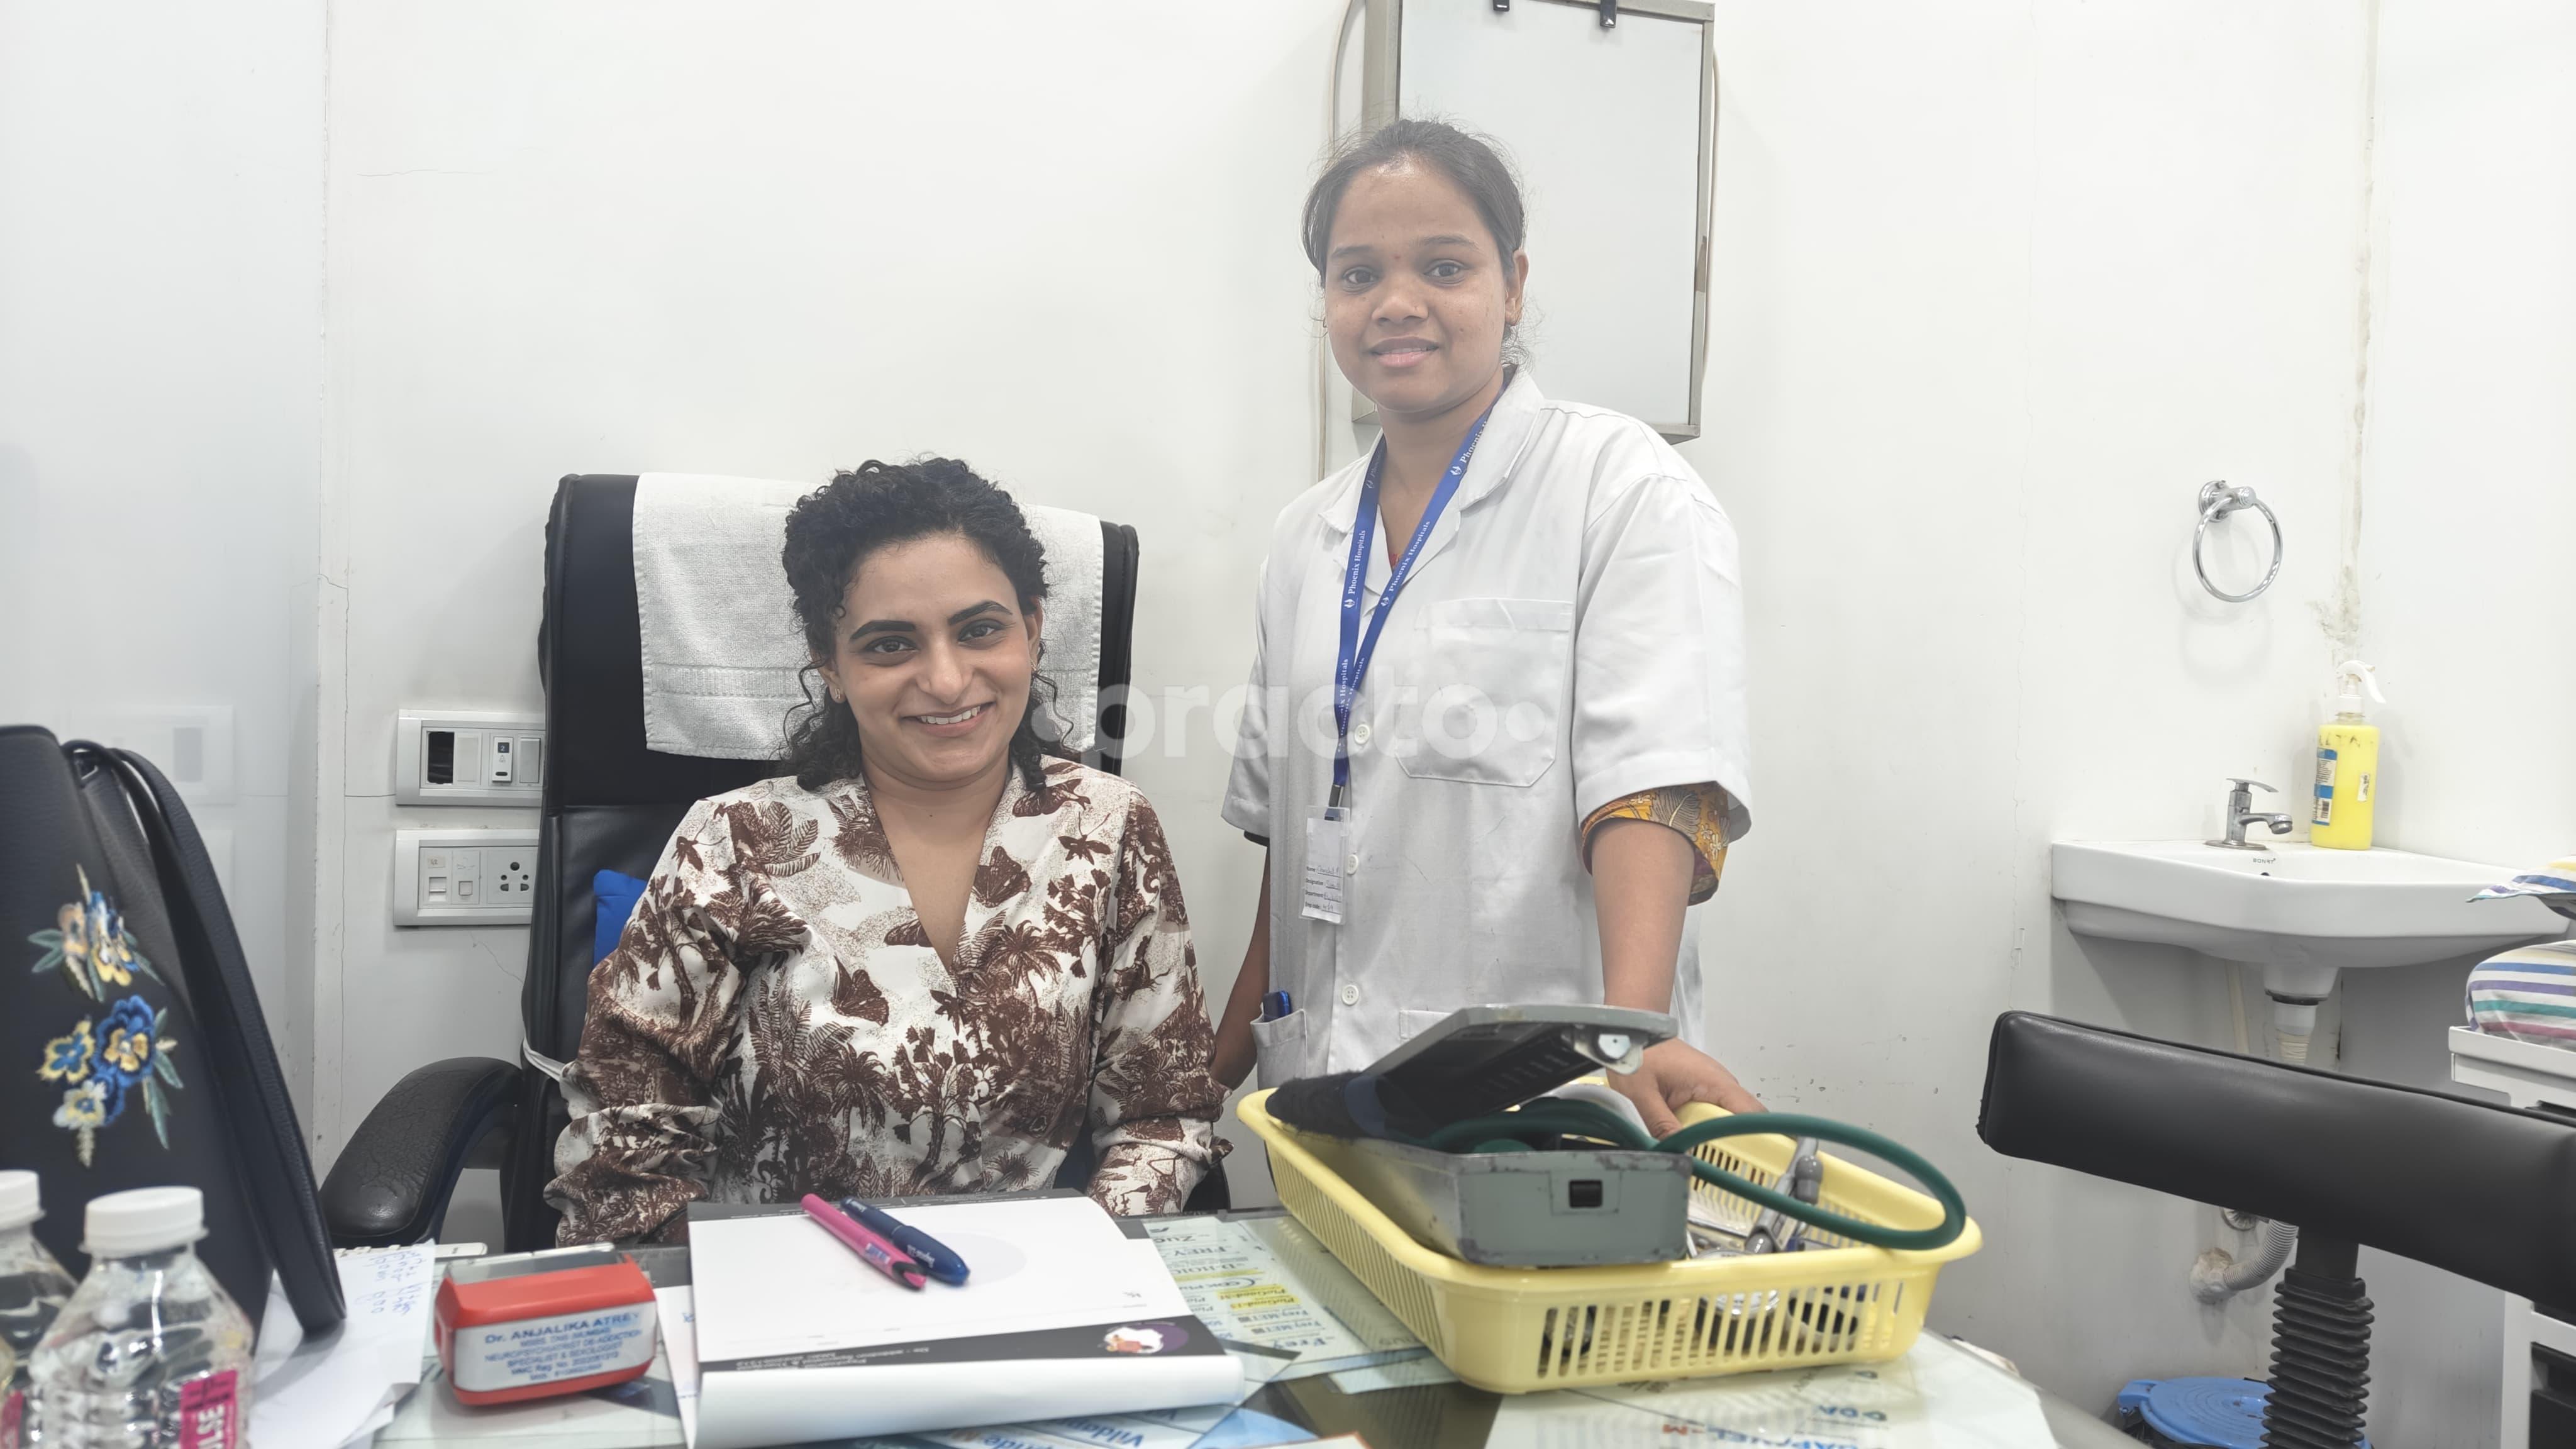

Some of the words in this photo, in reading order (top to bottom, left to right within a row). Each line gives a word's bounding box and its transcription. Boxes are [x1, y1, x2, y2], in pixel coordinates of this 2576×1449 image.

[1348, 564, 1360, 594] Phoenix
[1354, 530, 1365, 562] Hospitals
[1389, 557, 1411, 592] Phoenix
[1409, 521, 1431, 555] Hospitals
[1340, 658, 1349, 697] Hospitals
[511, 1321, 589, 1340] ANJALIKA
